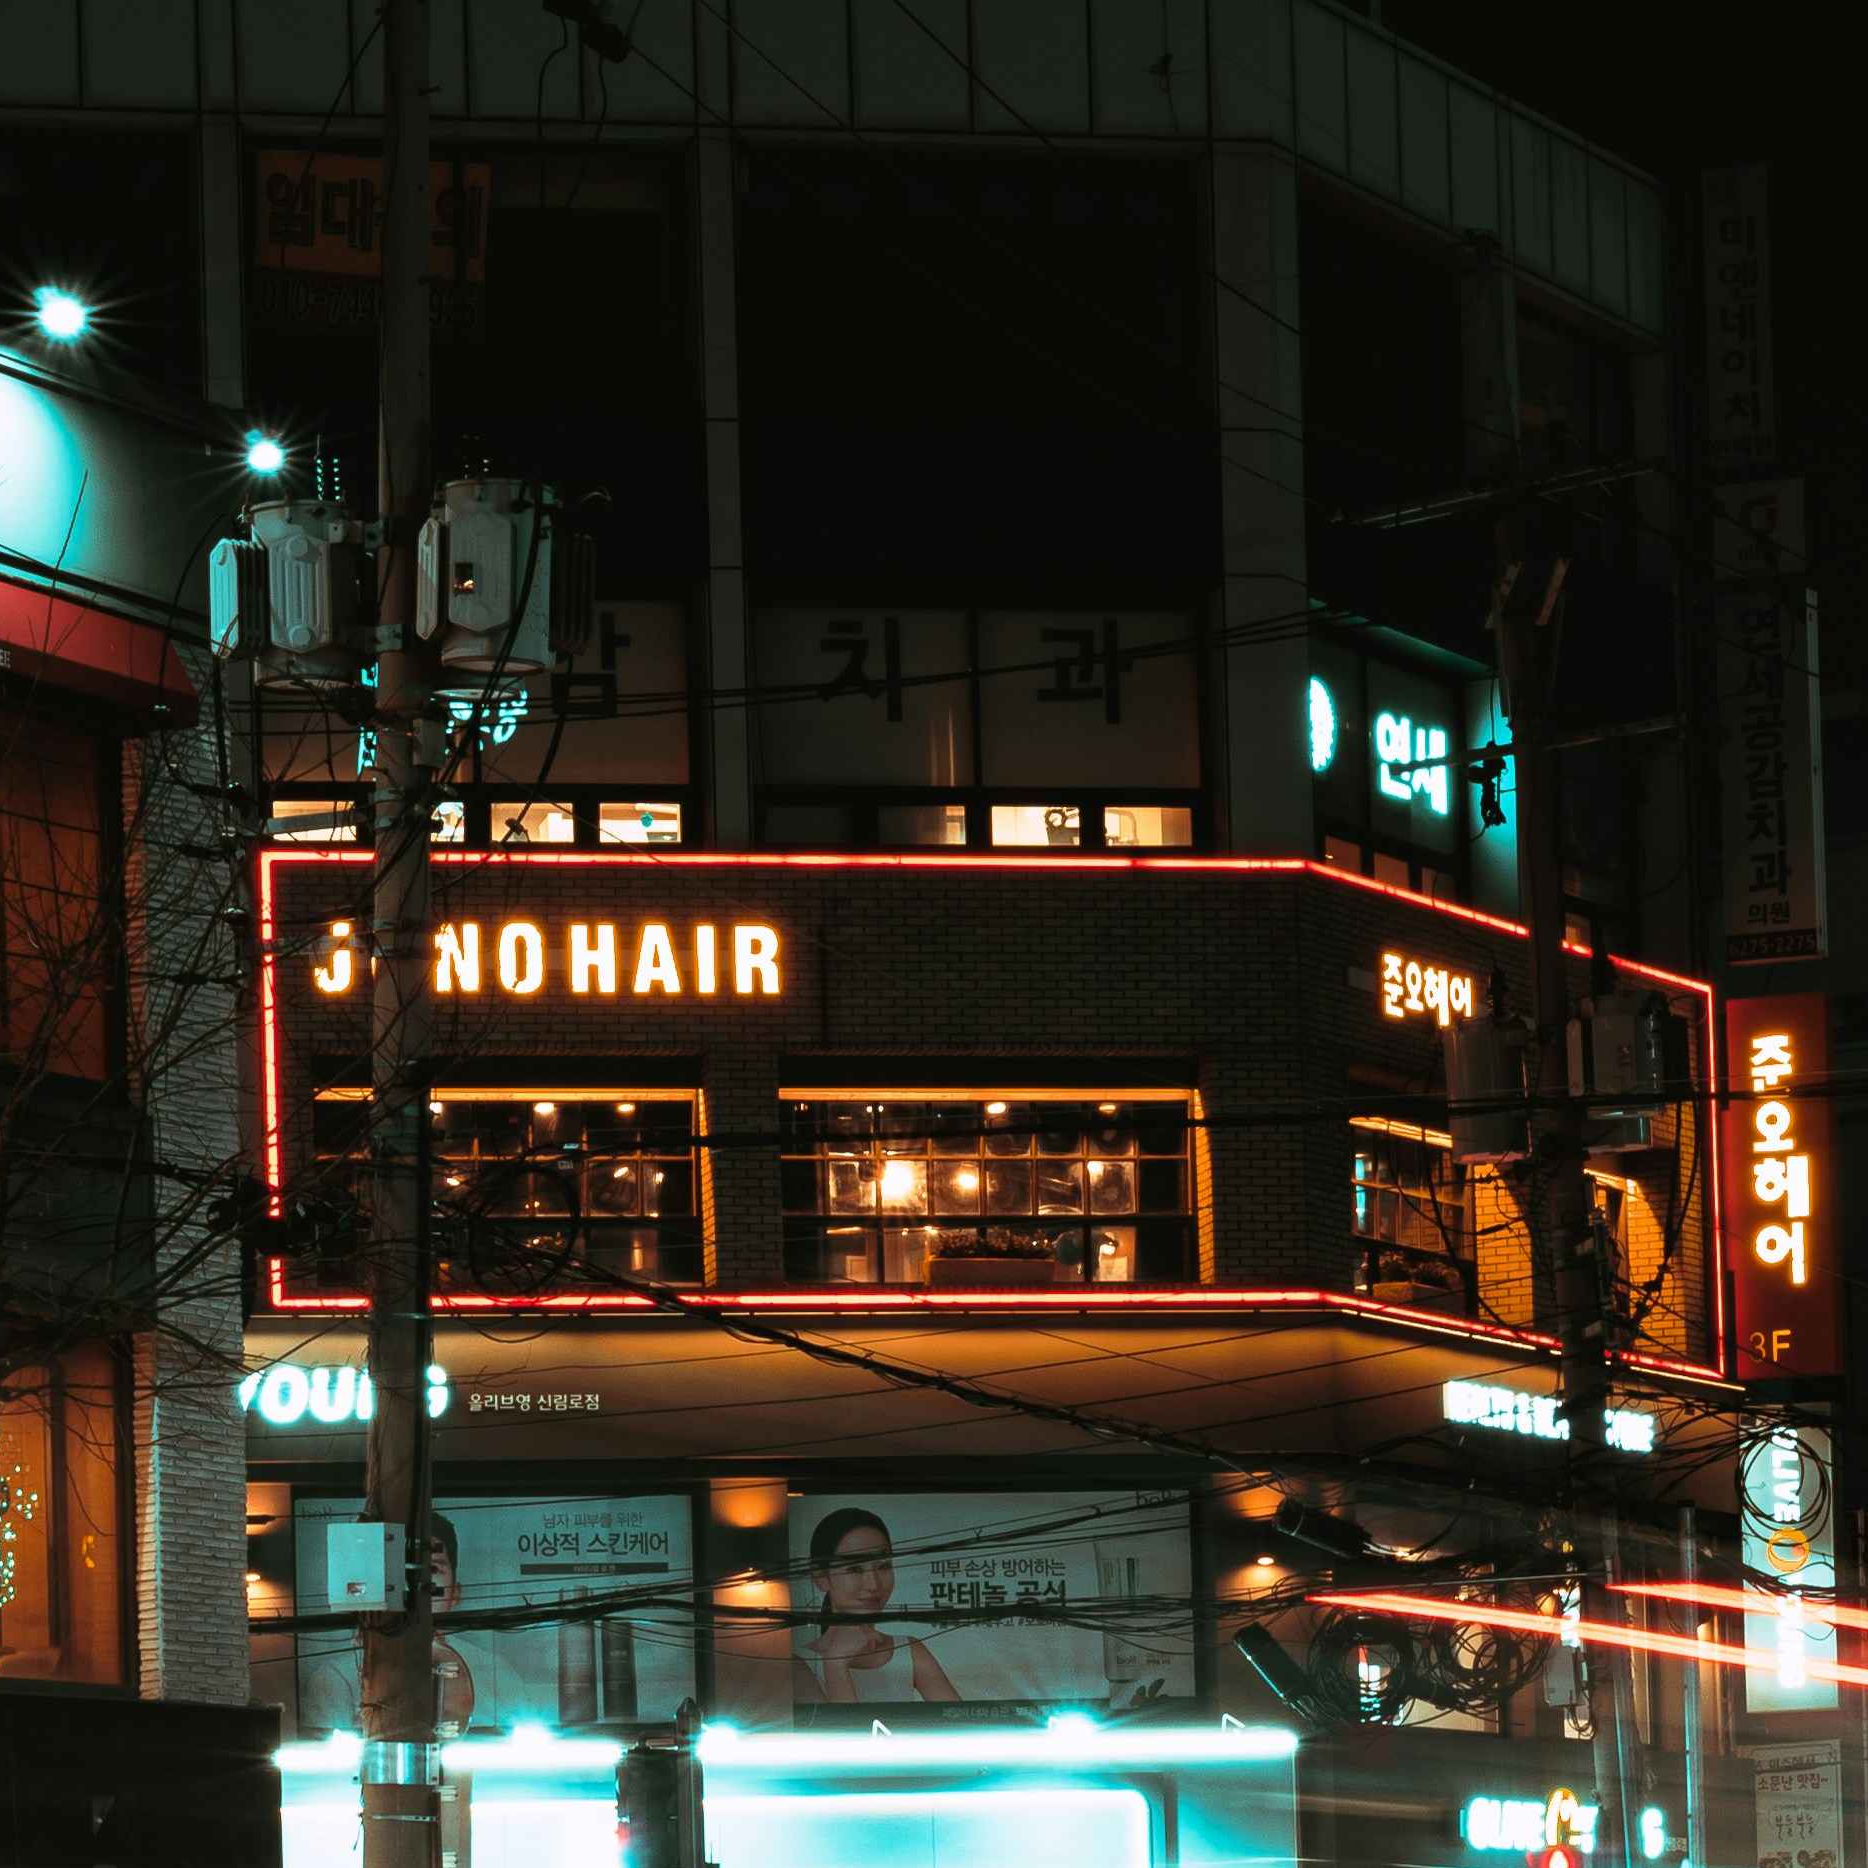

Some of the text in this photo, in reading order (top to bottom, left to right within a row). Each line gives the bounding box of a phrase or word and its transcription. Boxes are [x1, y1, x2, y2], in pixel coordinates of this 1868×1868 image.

[1376, 711, 1448, 815] 연세
[1748, 902, 1790, 924] 의원
[1383, 953, 1474, 1027] 준오헤어
[1750, 1035, 1810, 1285] 준오헤어
[469, 1393, 599, 1412] 올리브영 신림로점
[543, 1513, 570, 1529] 남자
[617, 1512, 645, 1528] 위한
[518, 1530, 670, 1558] 이상적 스킨케어
[931, 1557, 1066, 1577] 피부 손상 방어하는
